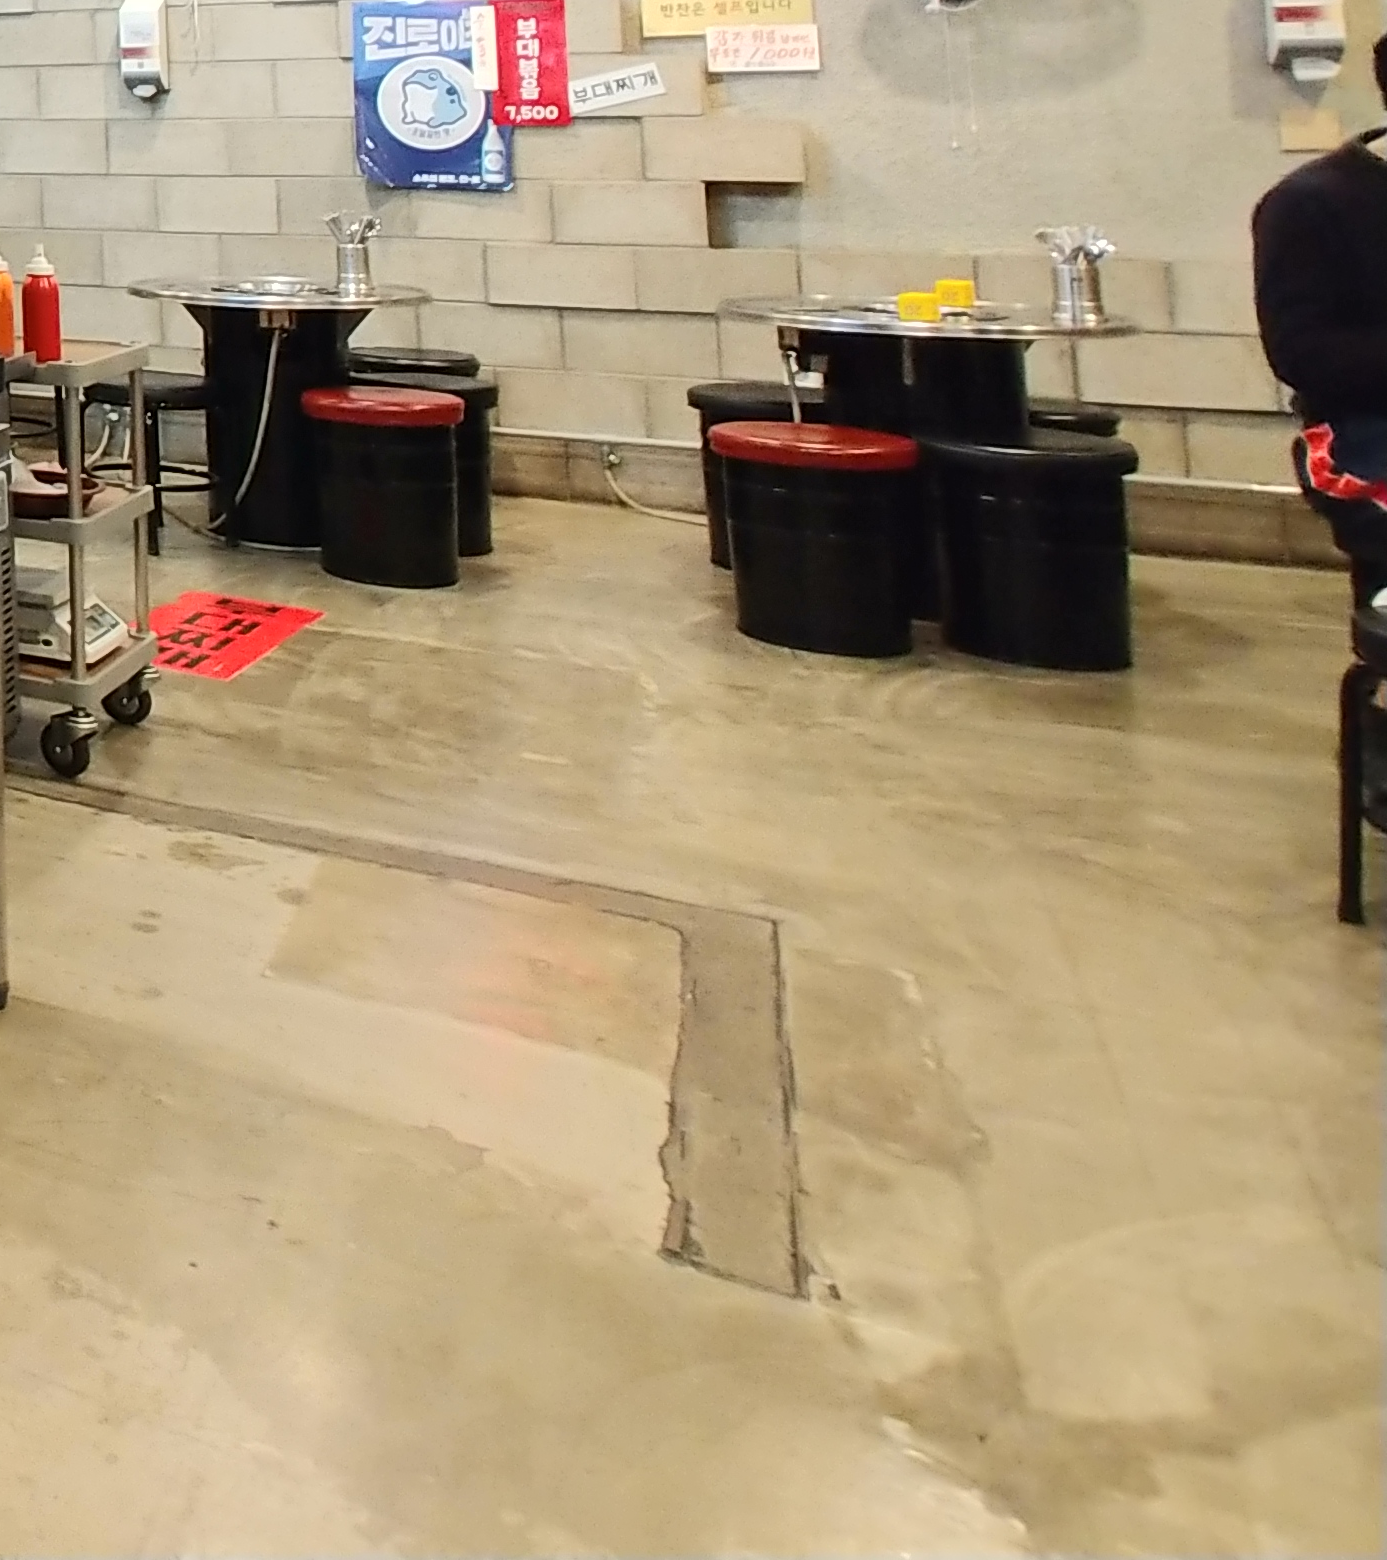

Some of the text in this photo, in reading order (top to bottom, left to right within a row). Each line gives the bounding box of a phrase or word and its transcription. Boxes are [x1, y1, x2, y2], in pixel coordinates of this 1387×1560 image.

[660, 2, 707, 20] 반찬은
[515, 16, 541, 101] 부대볶음
[571, 71, 659, 104] 부대찌개
[503, 105, 559, 123] 7,500
